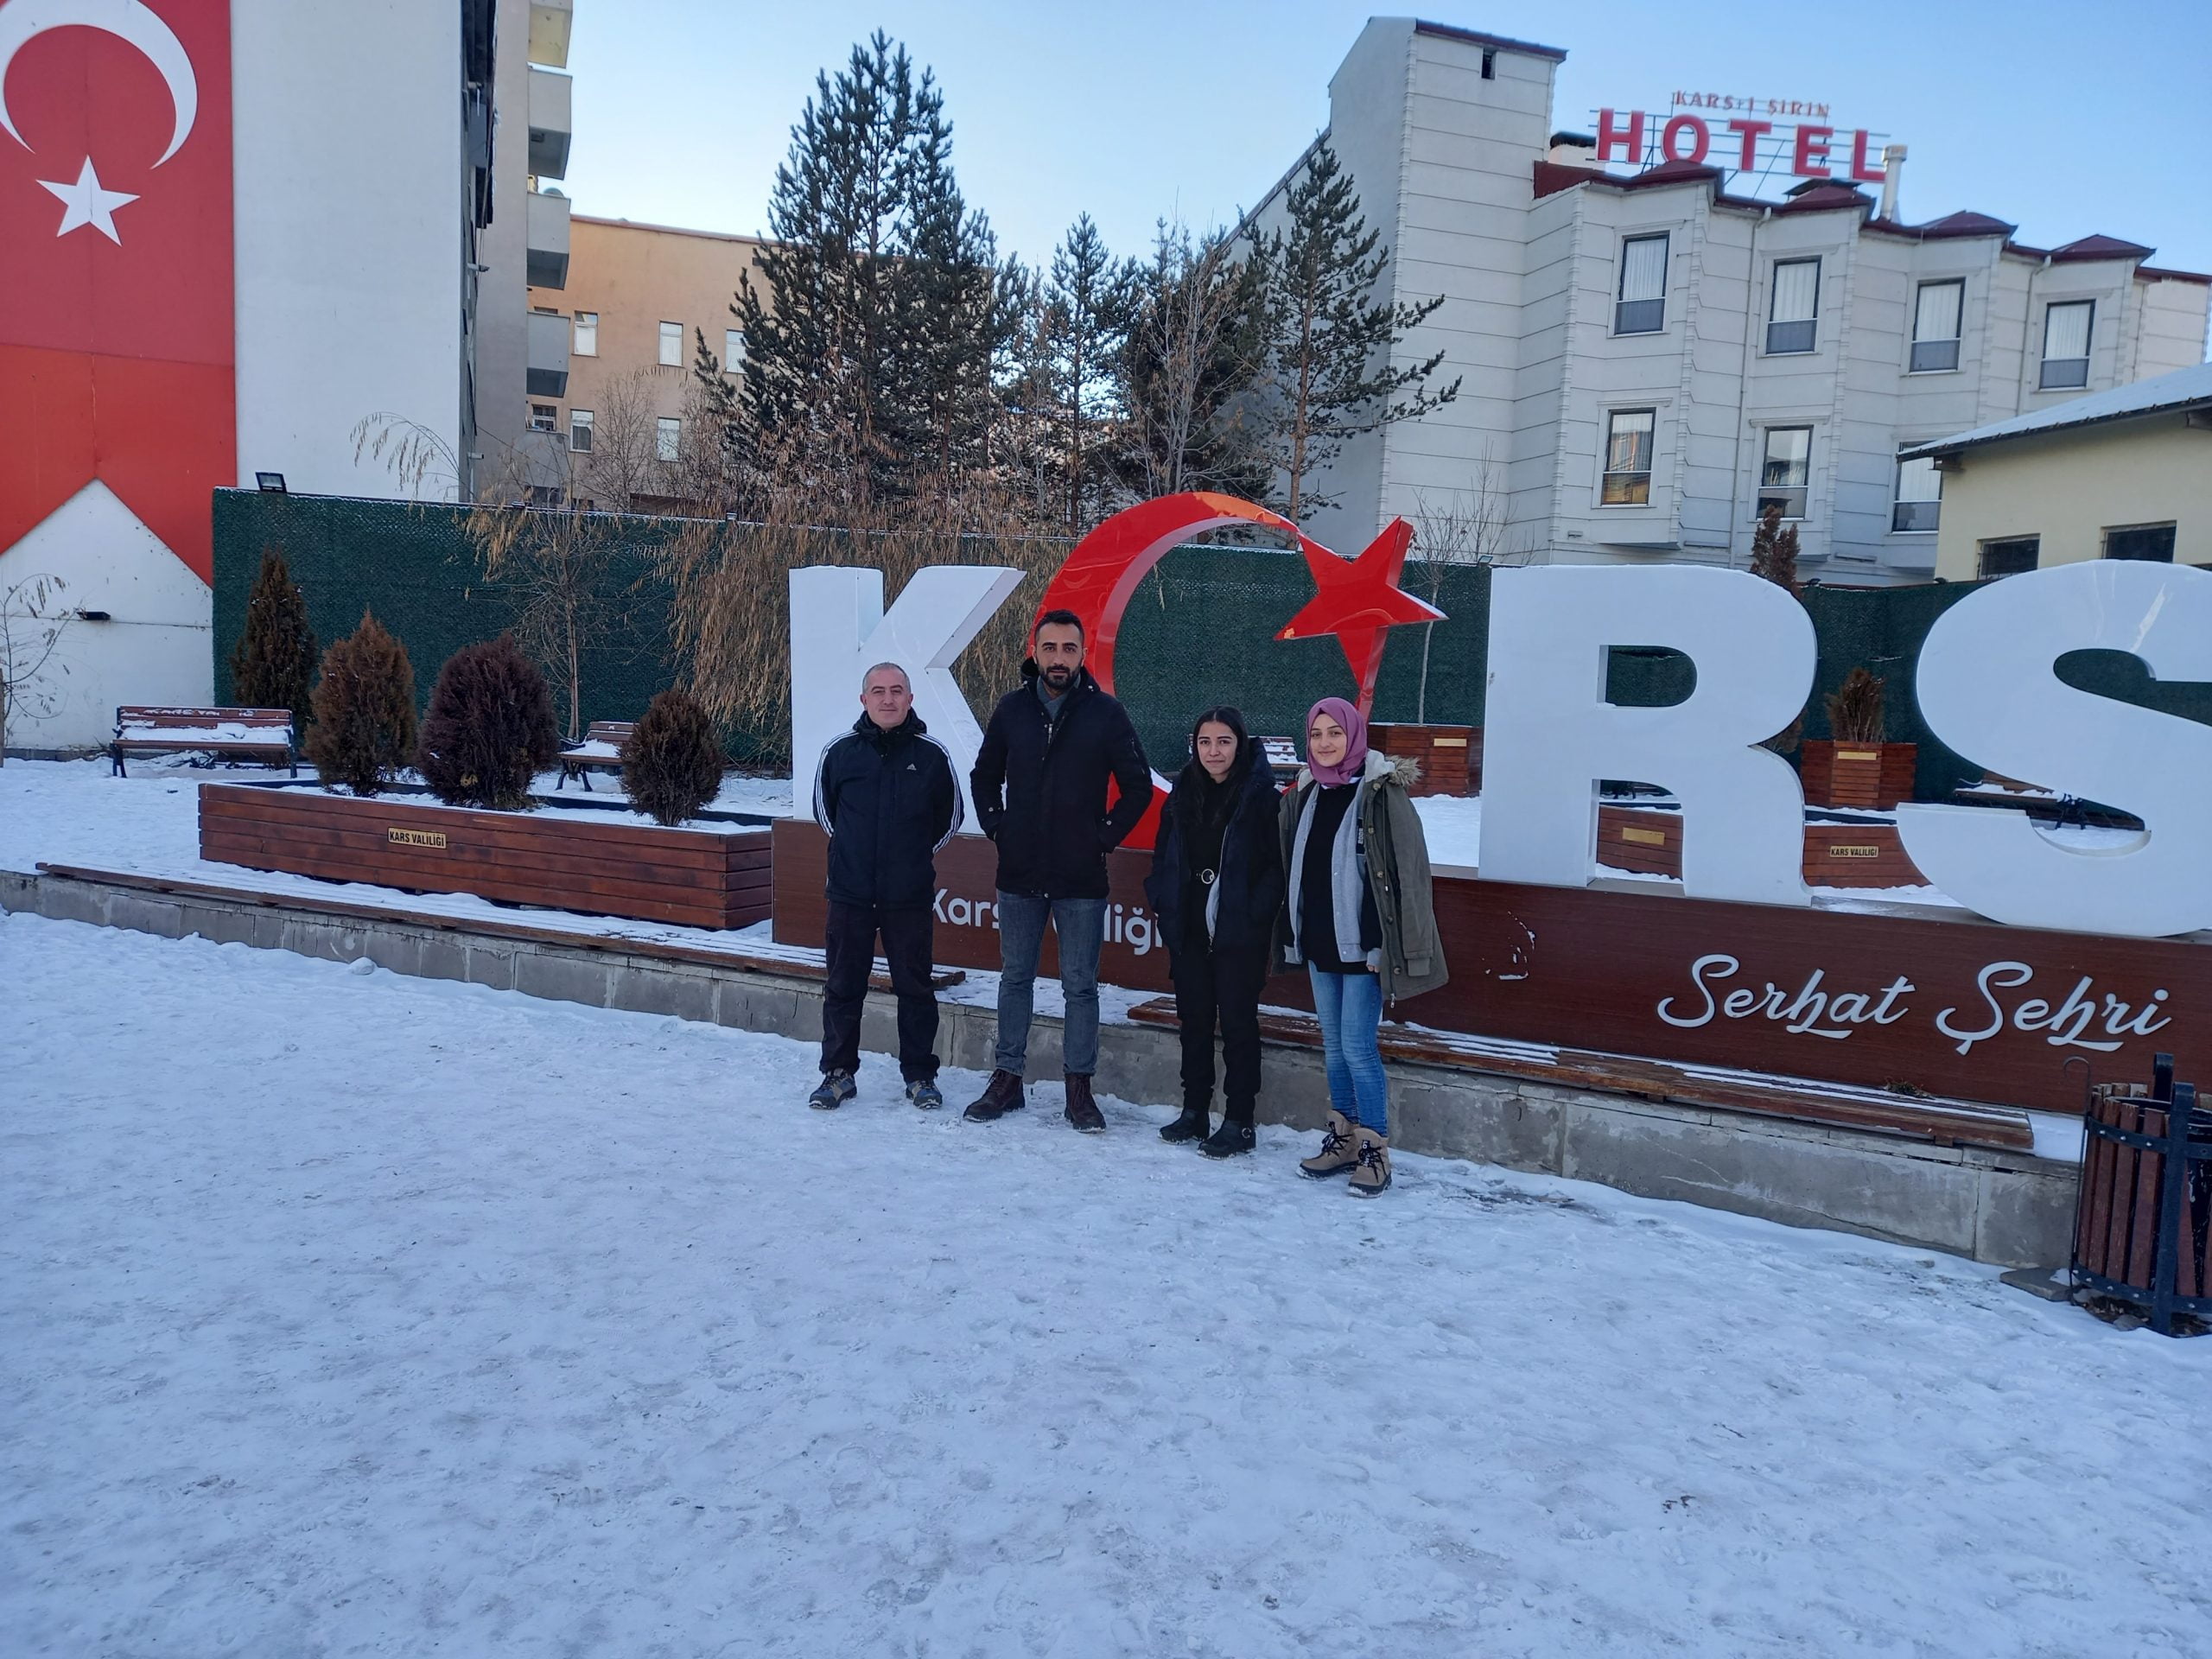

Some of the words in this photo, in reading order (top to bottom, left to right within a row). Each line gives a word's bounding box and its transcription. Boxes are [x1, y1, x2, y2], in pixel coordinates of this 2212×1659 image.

[1595, 107, 1887, 183] HOTEL
[389, 831, 410, 842] KARS
[1831, 848, 1849, 856] KARS
[1657, 954, 1916, 1039] Serhat
[1936, 961, 2172, 1056] Şehri
